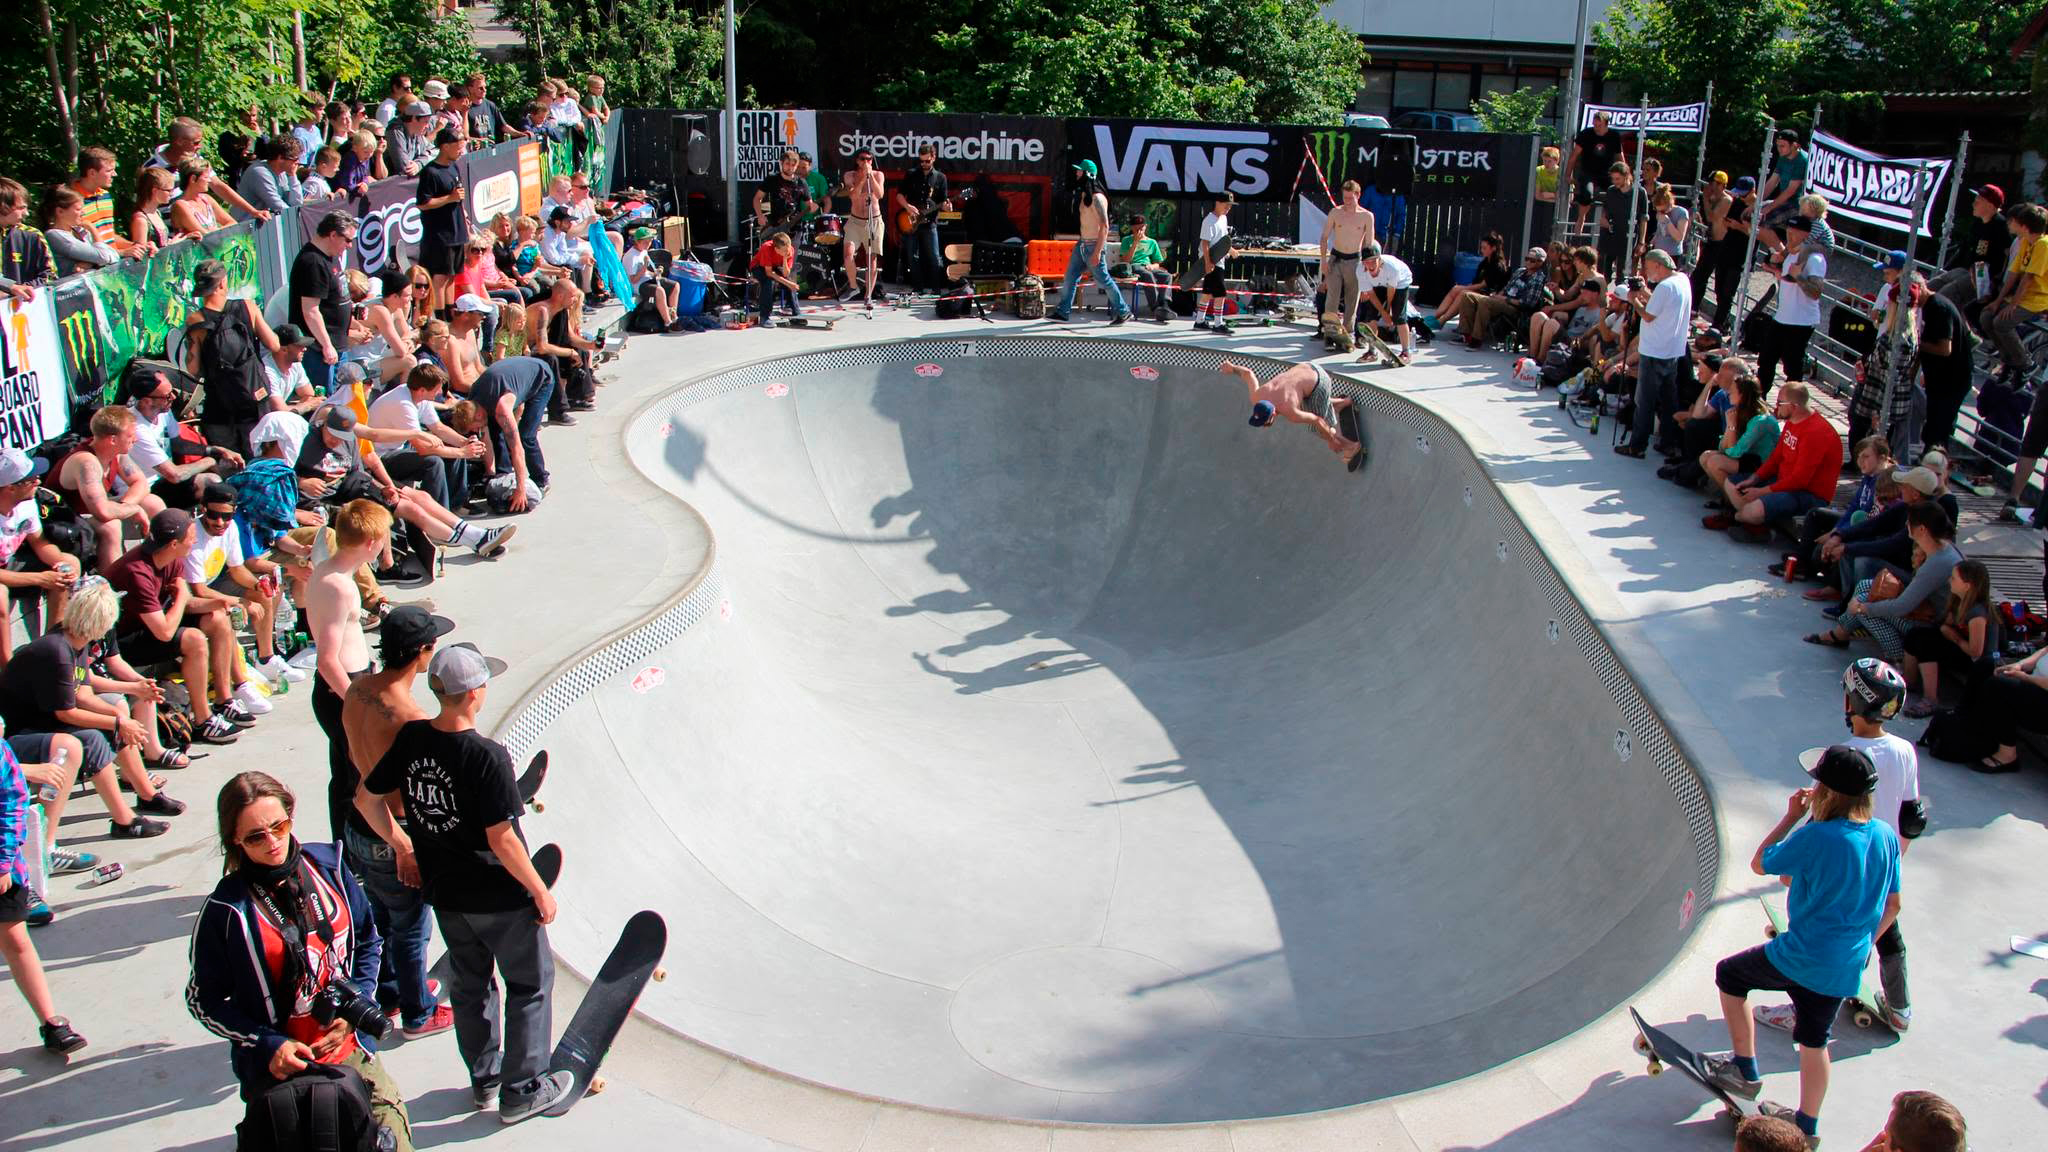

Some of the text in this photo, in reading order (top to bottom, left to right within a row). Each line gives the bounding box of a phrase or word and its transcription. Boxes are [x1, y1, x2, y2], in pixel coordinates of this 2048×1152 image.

[737, 112, 786, 146] GIRL
[838, 129, 1045, 162] streetmachine
[1093, 125, 1270, 195] VANS
[1358, 145, 1492, 171] MSTER
[264, 896, 286, 925] DIGITAL
[310, 892, 325, 921] Canon
